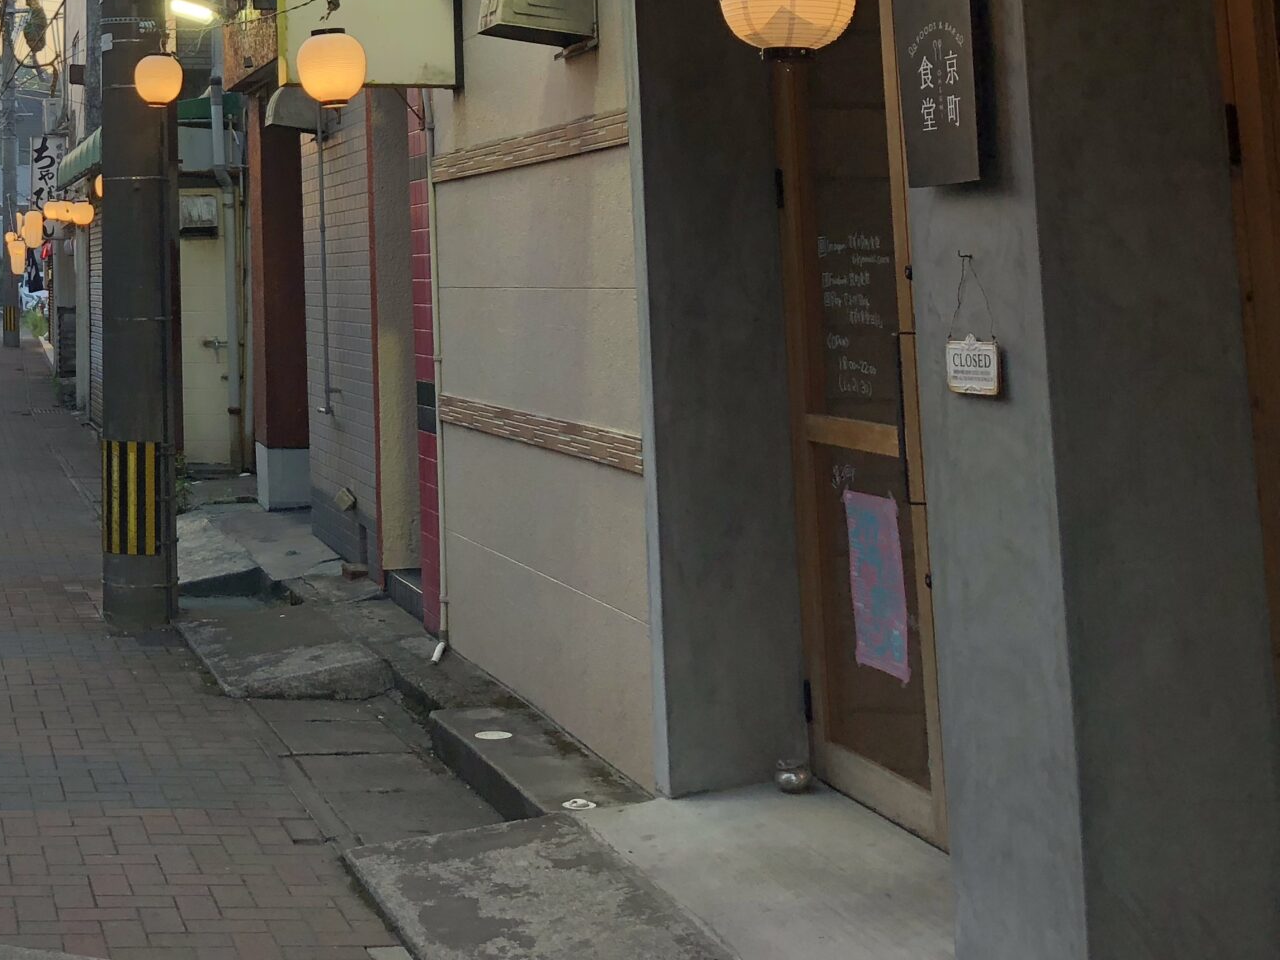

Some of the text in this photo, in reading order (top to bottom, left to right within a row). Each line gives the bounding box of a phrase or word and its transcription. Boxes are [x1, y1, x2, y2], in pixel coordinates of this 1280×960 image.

[918, 55, 938, 132] 食堂
[944, 50, 961, 127] 京町
[952, 353, 992, 369] CLOSED
